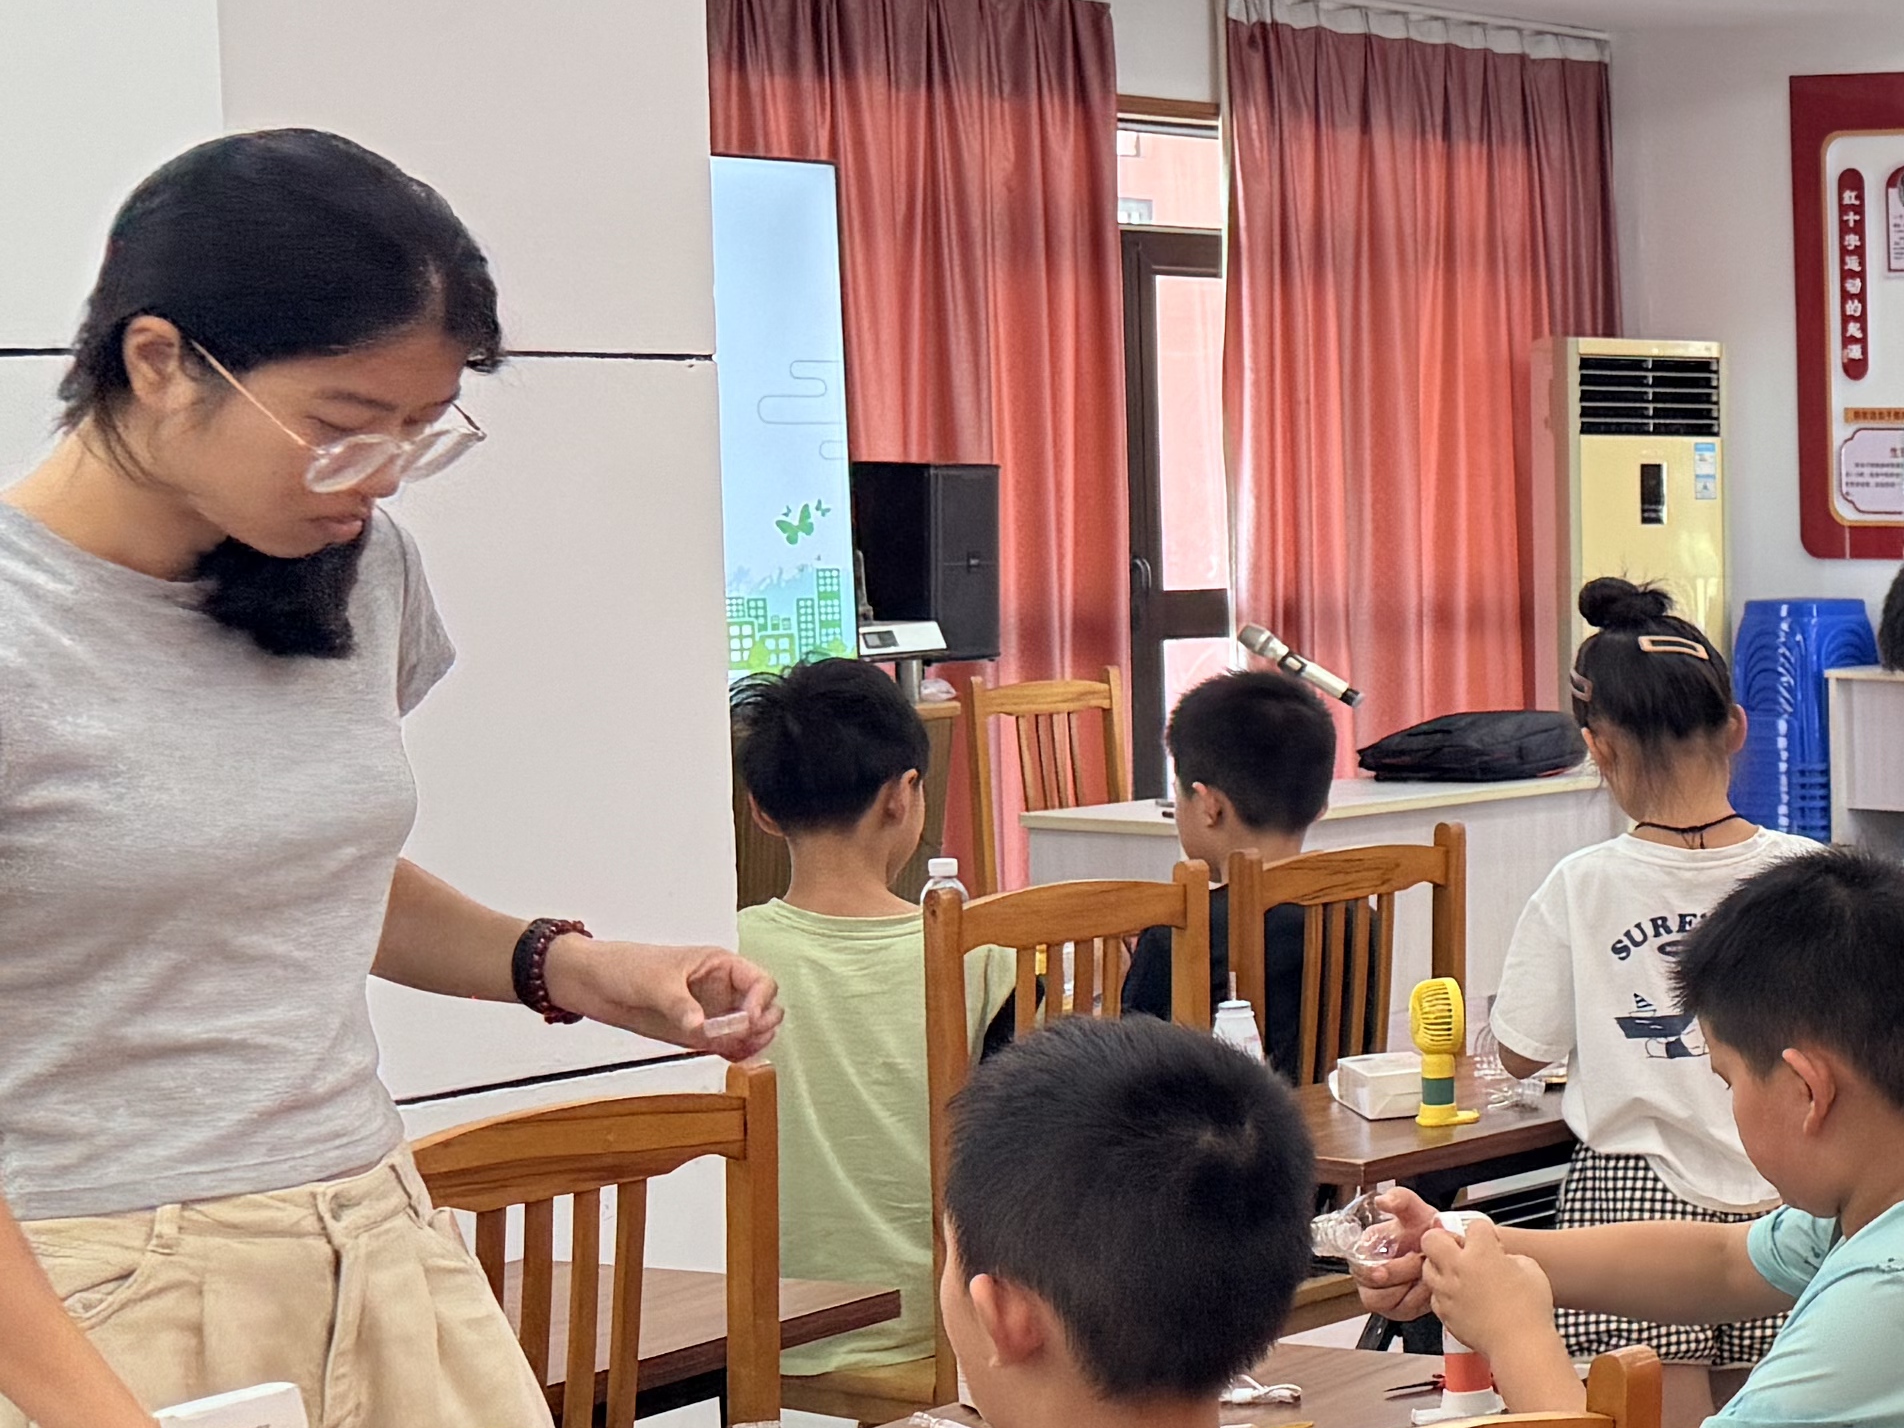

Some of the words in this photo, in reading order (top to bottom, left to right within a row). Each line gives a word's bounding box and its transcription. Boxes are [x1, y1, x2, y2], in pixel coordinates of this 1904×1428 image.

[1842, 189, 1863, 361] 红十字运动的起源
[1611, 913, 1708, 961] SURF
